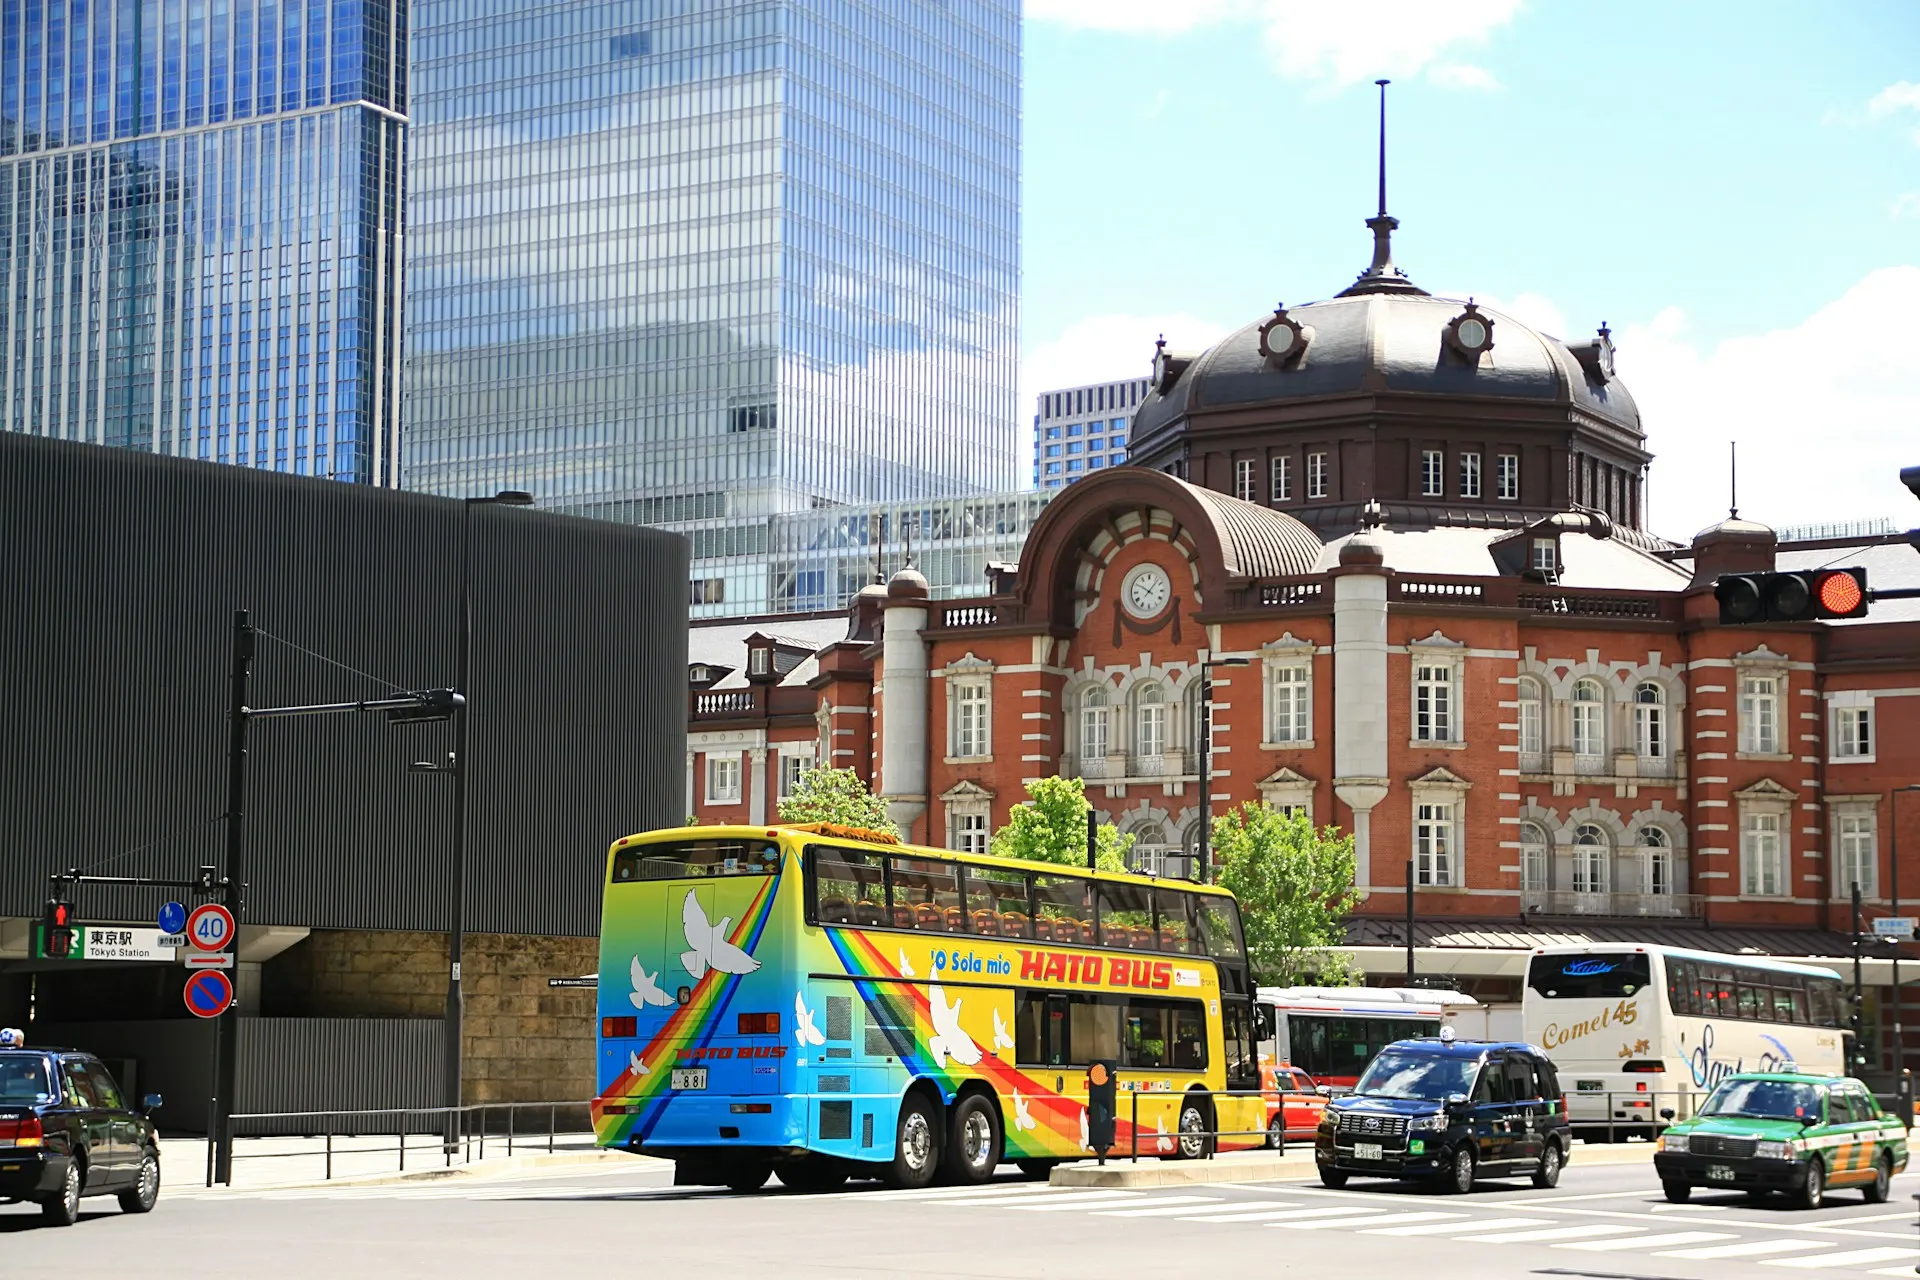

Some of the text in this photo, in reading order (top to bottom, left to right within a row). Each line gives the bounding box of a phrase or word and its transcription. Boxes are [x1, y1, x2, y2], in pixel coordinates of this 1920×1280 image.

[197, 917, 223, 938] 40
[90, 931, 132, 946] 東京駅
[119, 948, 150, 957] Station
[951, 951, 982, 972] Sola
[986, 953, 1011, 975] mio
[1015, 949, 1173, 989] HATO BUS
[1542, 999, 1638, 1050] Comet 45
[673, 1046, 788, 1059] HATO BUS
[683, 1075, 704, 1088] 881
